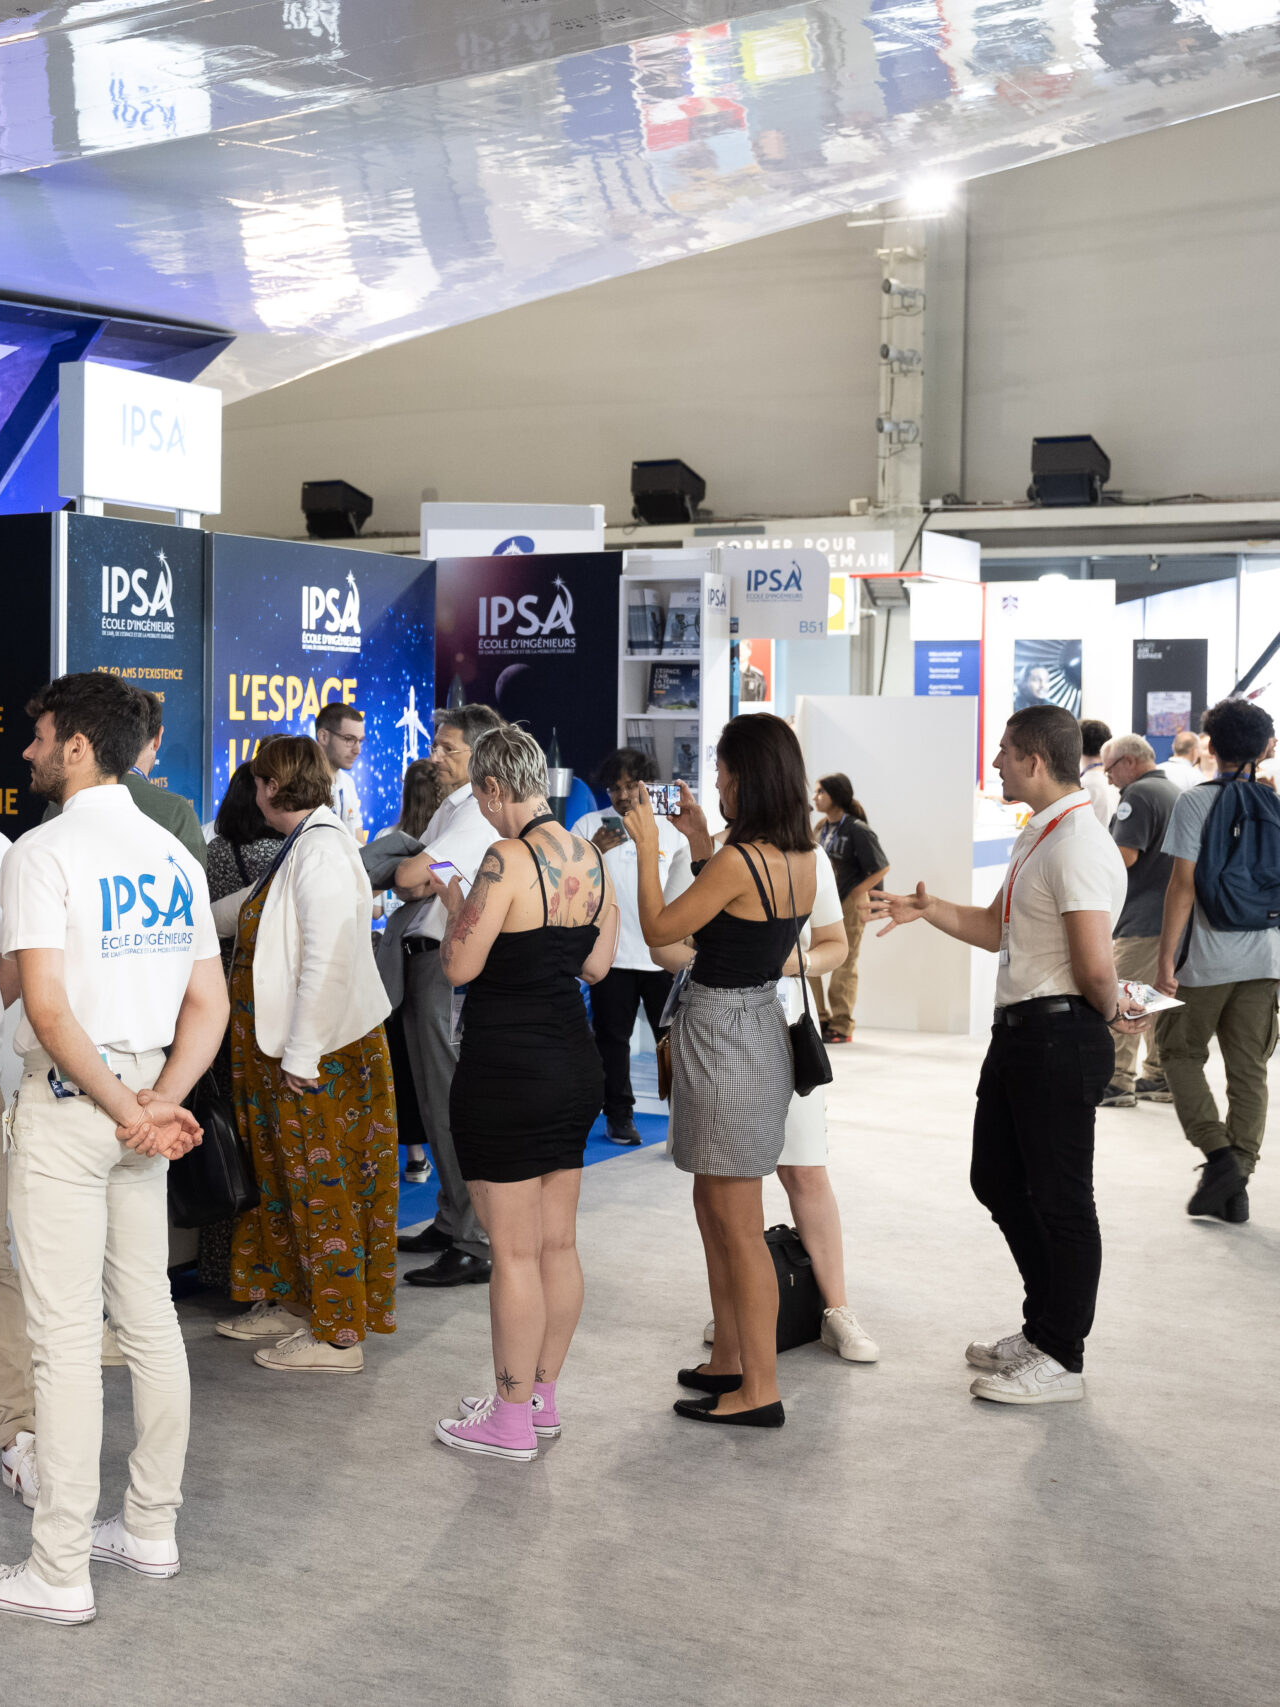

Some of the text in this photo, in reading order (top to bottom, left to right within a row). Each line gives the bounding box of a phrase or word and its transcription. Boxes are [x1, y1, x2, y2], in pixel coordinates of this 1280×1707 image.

[122, 403, 186, 456] IPSA
[828, 553, 889, 568] EMAIN
[747, 568, 803, 592] IPSA
[102, 566, 175, 617] IPSA
[707, 589, 727, 607] IPSA
[302, 586, 361, 634] IPSA
[479, 594, 576, 636] IPSA
[102, 616, 175, 633] ÉCOLE D'INGÉNIEURS
[799, 621, 824, 634] B51
[479, 636, 576, 649] ÉCOLE D'INGÉNIEURS
[122, 667, 137, 679] ANS
[138, 668, 183, 680] D'EXISTENCE
[99, 873, 195, 932] IPSA
